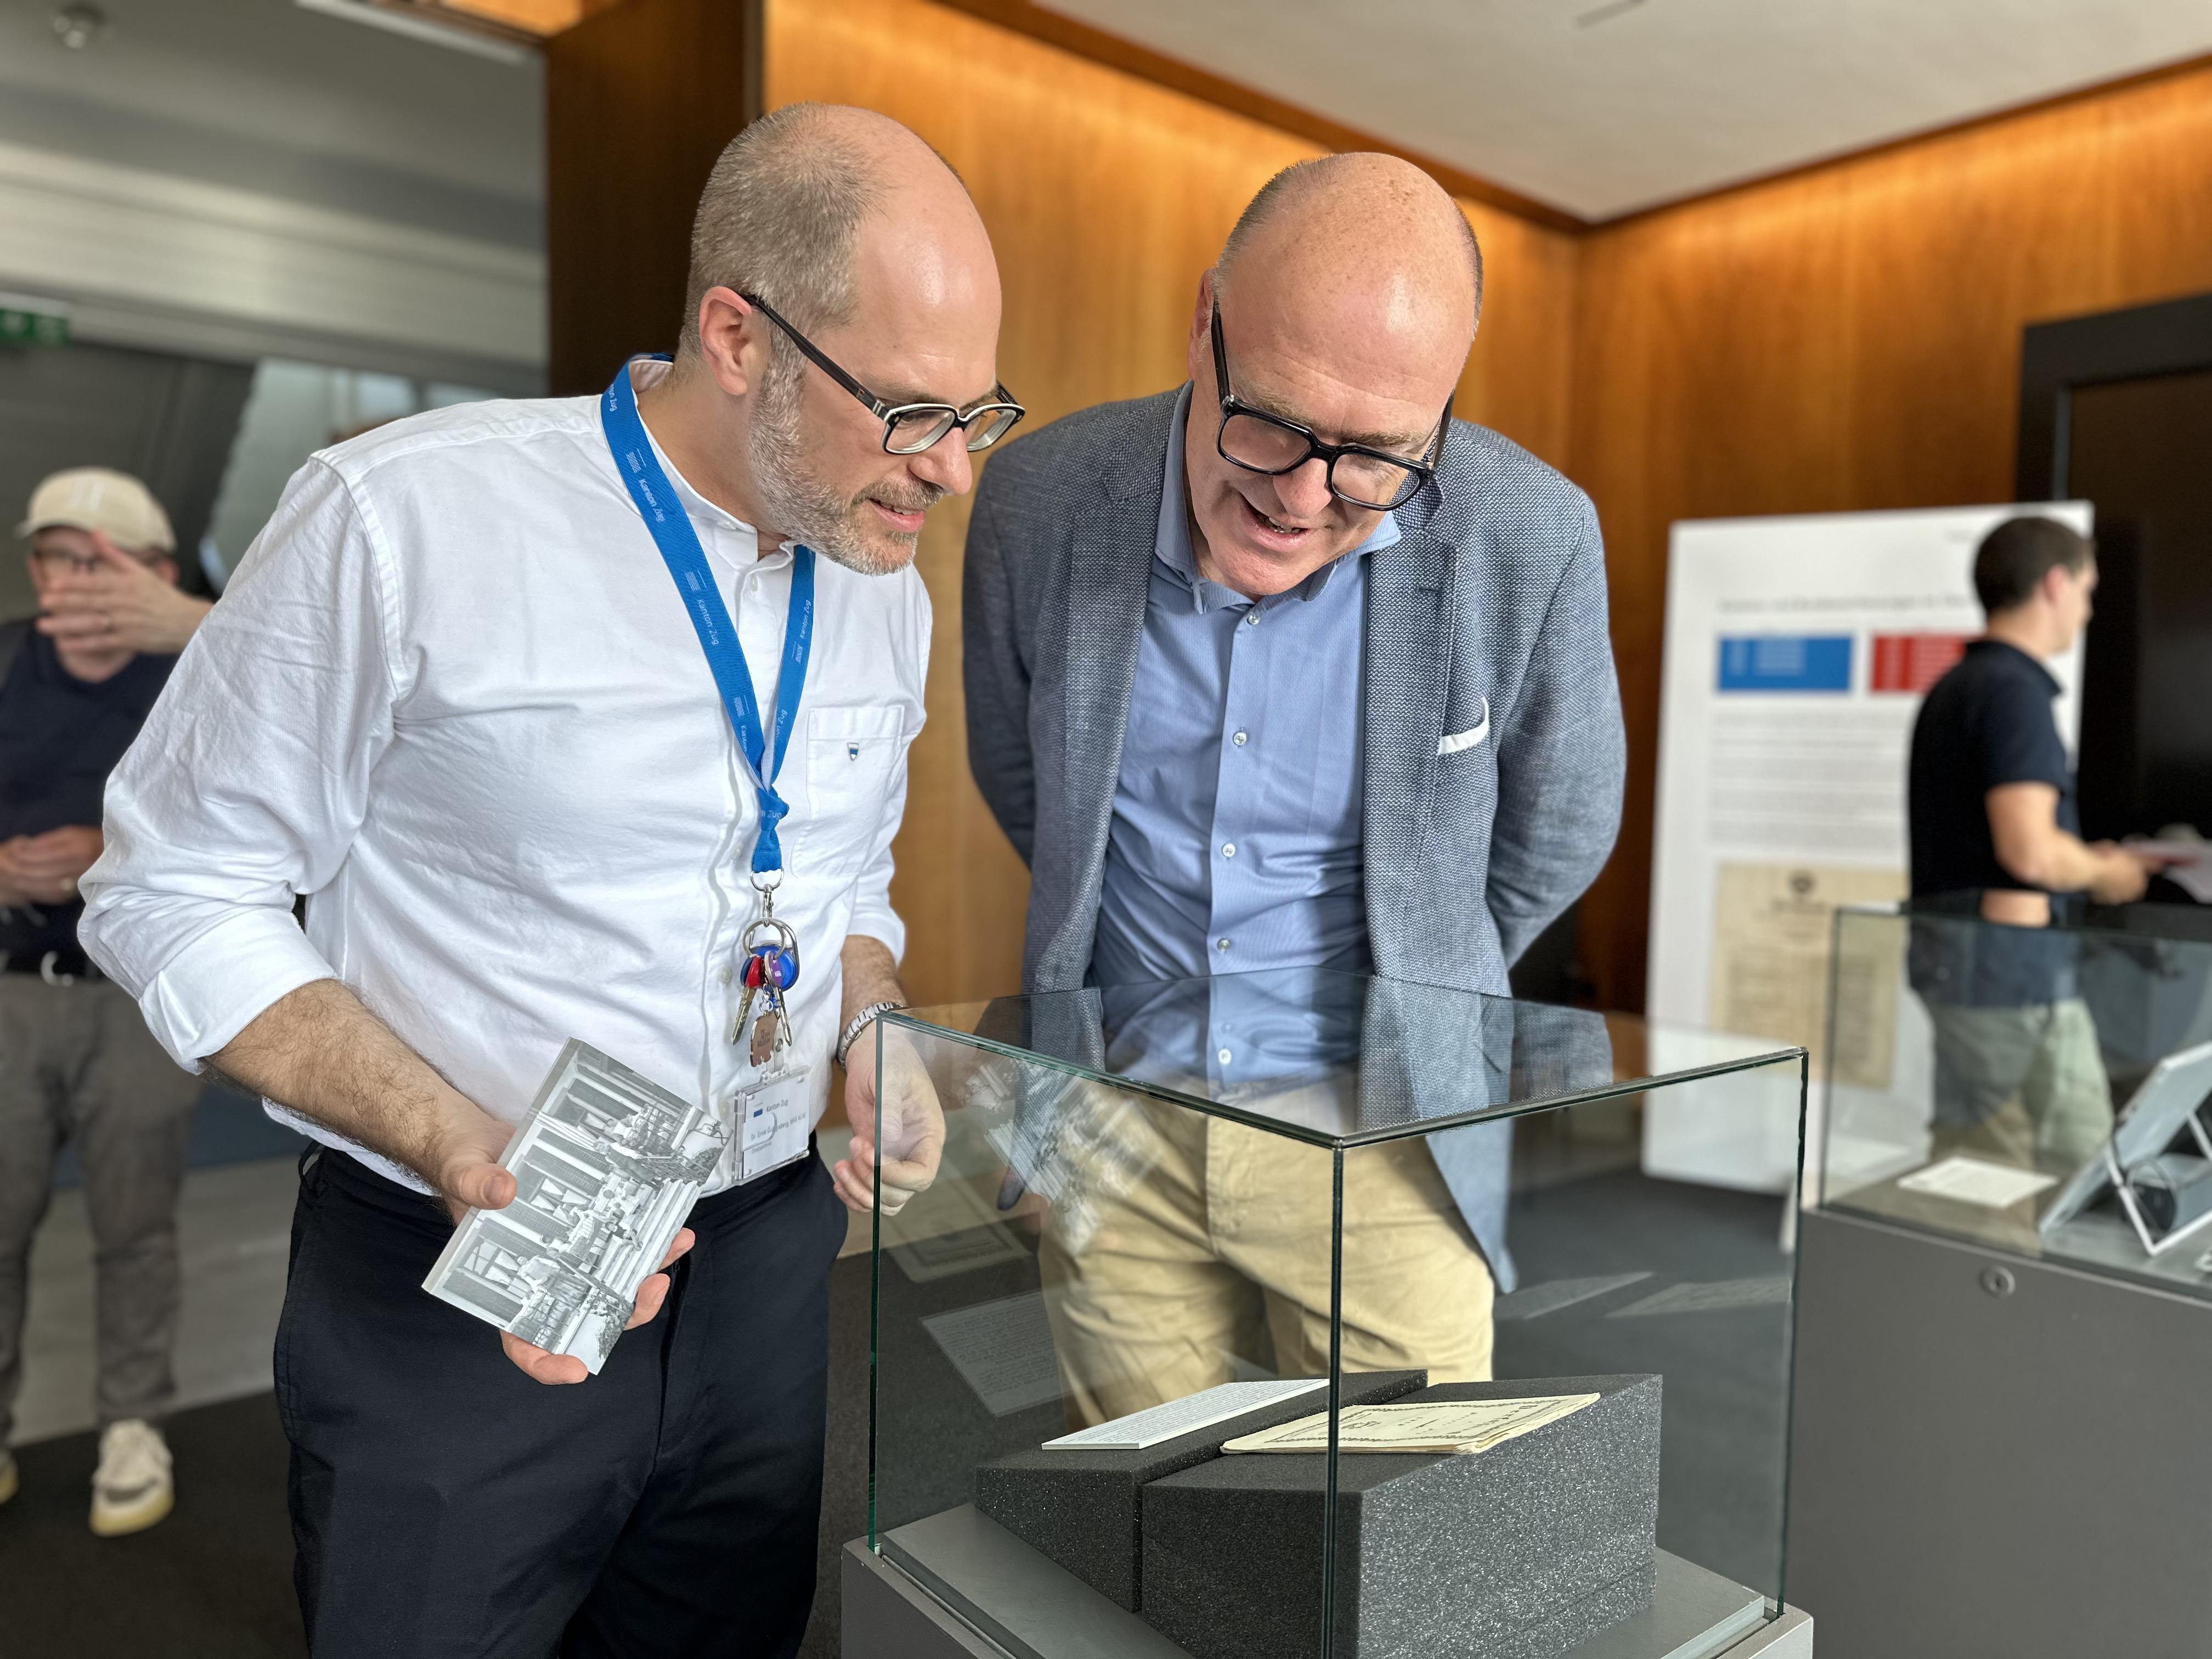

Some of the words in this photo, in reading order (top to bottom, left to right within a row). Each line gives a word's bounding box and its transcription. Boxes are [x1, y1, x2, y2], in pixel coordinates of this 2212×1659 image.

[638, 478, 657, 507] Kanton
[653, 508, 665, 522] Zug
[803, 600, 811, 614] Zug
[697, 599, 713, 627] Kanton
[709, 629, 719, 645] Zug
[800, 614, 808, 639] Kanton
[778, 709, 787, 724] Zug
[766, 1103, 780, 1113] Kanton
